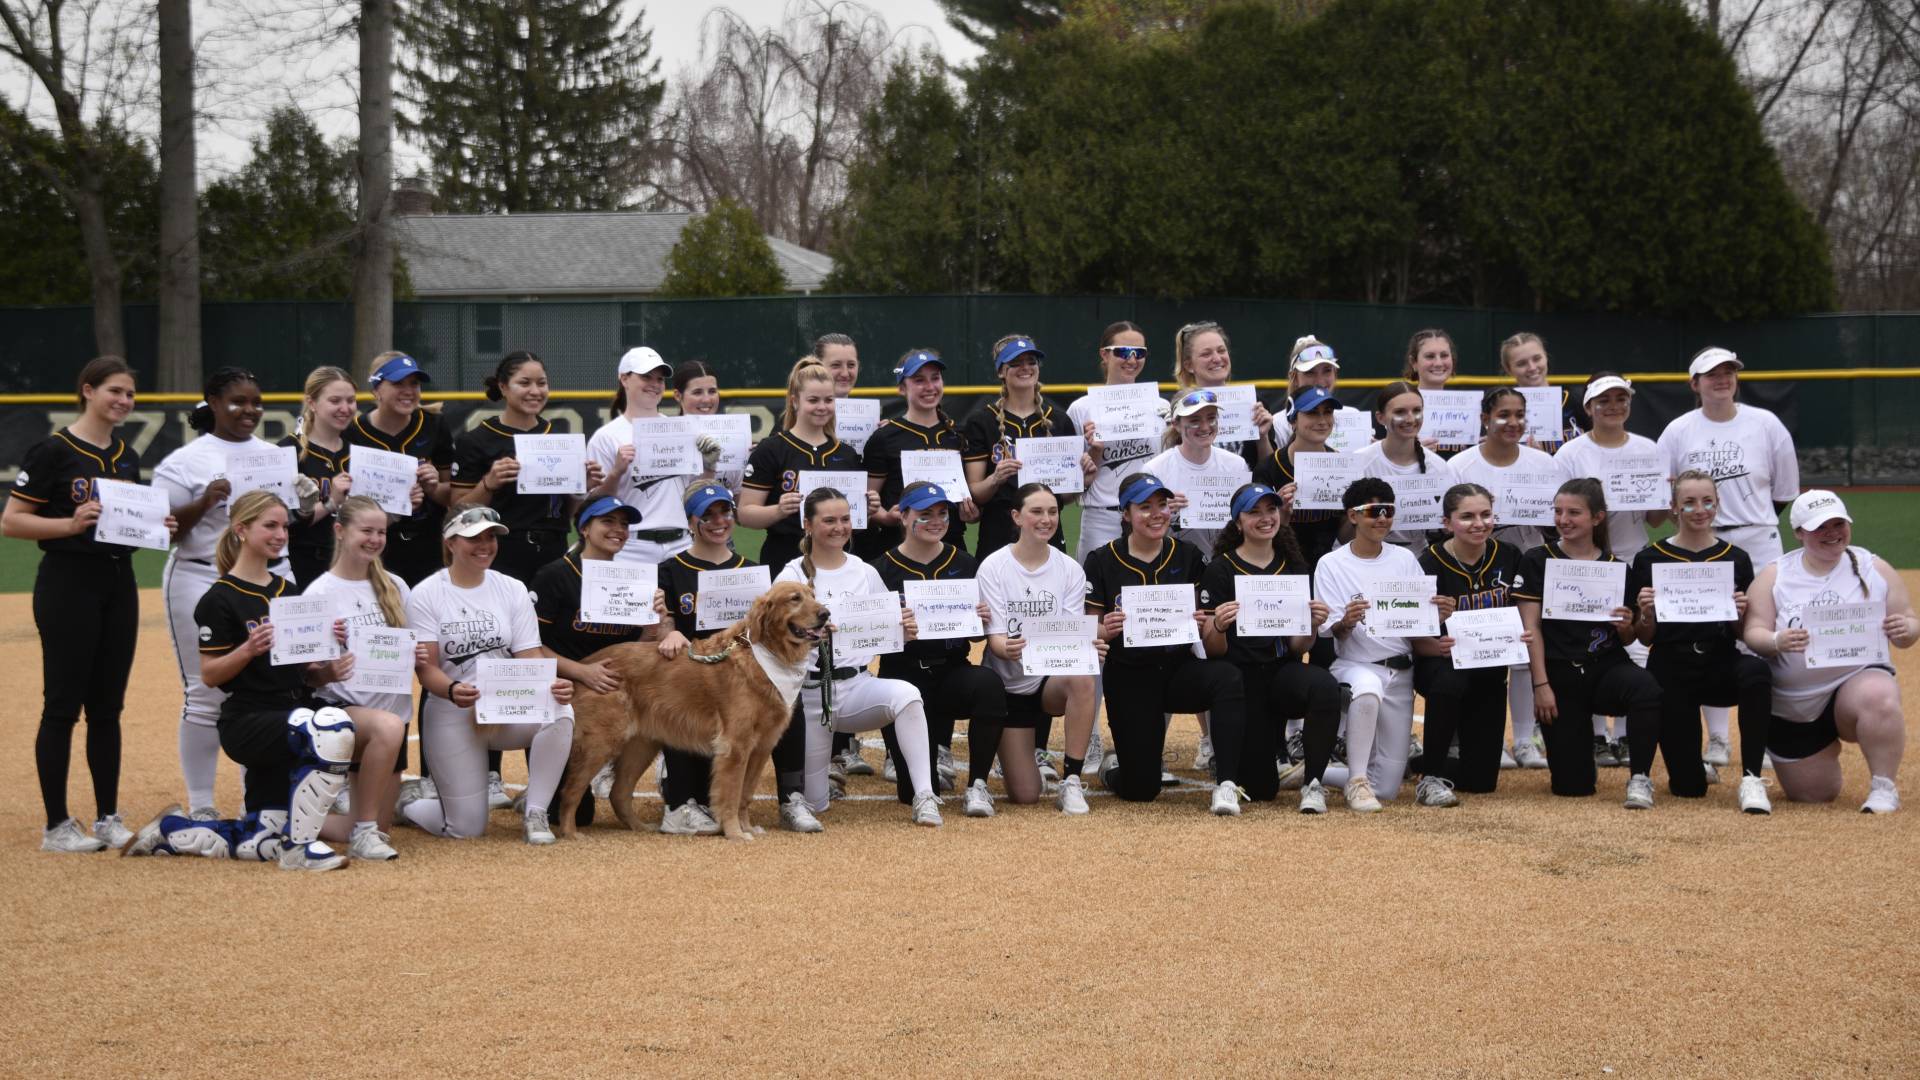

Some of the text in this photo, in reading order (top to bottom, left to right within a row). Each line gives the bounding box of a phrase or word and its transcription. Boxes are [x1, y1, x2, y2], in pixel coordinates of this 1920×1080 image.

[1101, 444, 1151, 462] Cancer
[1688, 450, 1738, 464] STRIKE
[1400, 497, 1432, 509] Grandma
[1505, 495, 1518, 506] My
[706, 597, 722, 609] Joe
[1007, 600, 1053, 613] STRIKE
[1254, 599, 1282, 612] Pam
[1376, 599, 1389, 611] My
[440, 620, 496, 636] STRIKE
[839, 622, 865, 633] Auntie
[1818, 626, 1846, 637] Leslie
[444, 637, 504, 656] Cancer
[496, 688, 536, 700] everyone
